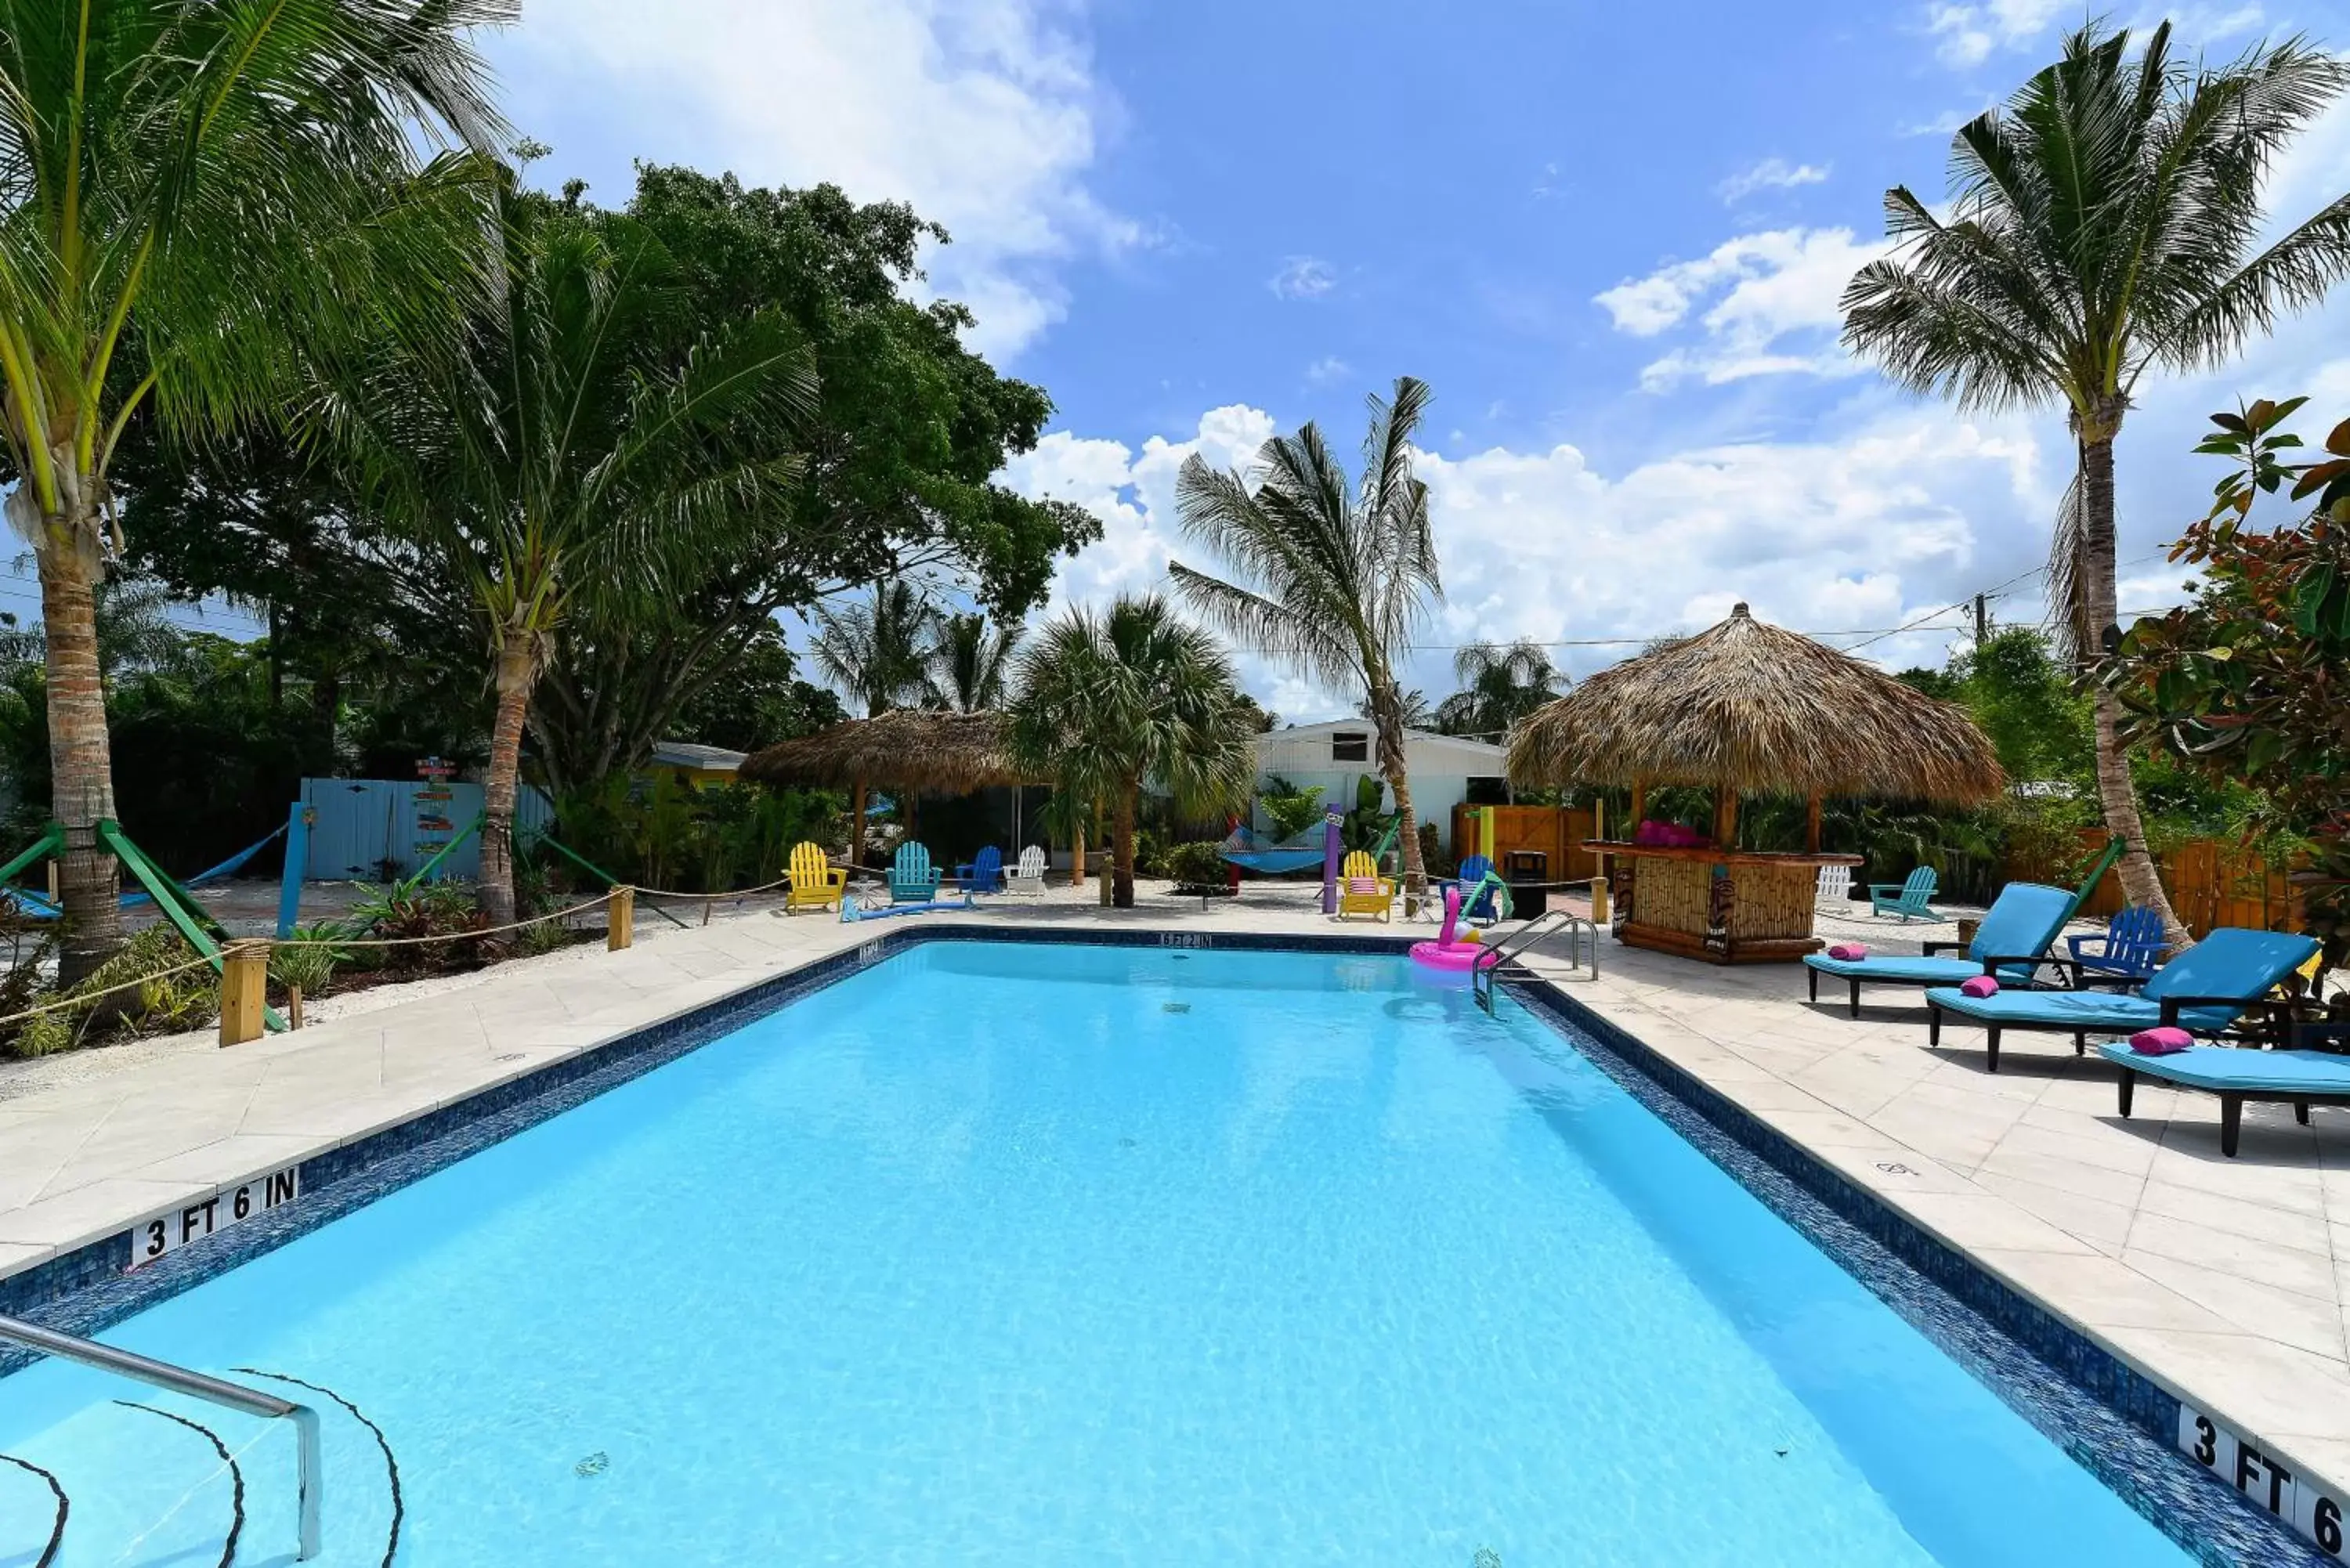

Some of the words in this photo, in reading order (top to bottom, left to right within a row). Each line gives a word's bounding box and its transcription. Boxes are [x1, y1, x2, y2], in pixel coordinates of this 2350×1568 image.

[146, 1219, 166, 1256] 3
[182, 1196, 220, 1244] FT
[233, 1186, 251, 1219] 6
[266, 1168, 295, 1209] IN
[2193, 1415, 2217, 1467] 3
[2236, 1439, 2291, 1516] FT
[2313, 1496, 2343, 1555] 6
